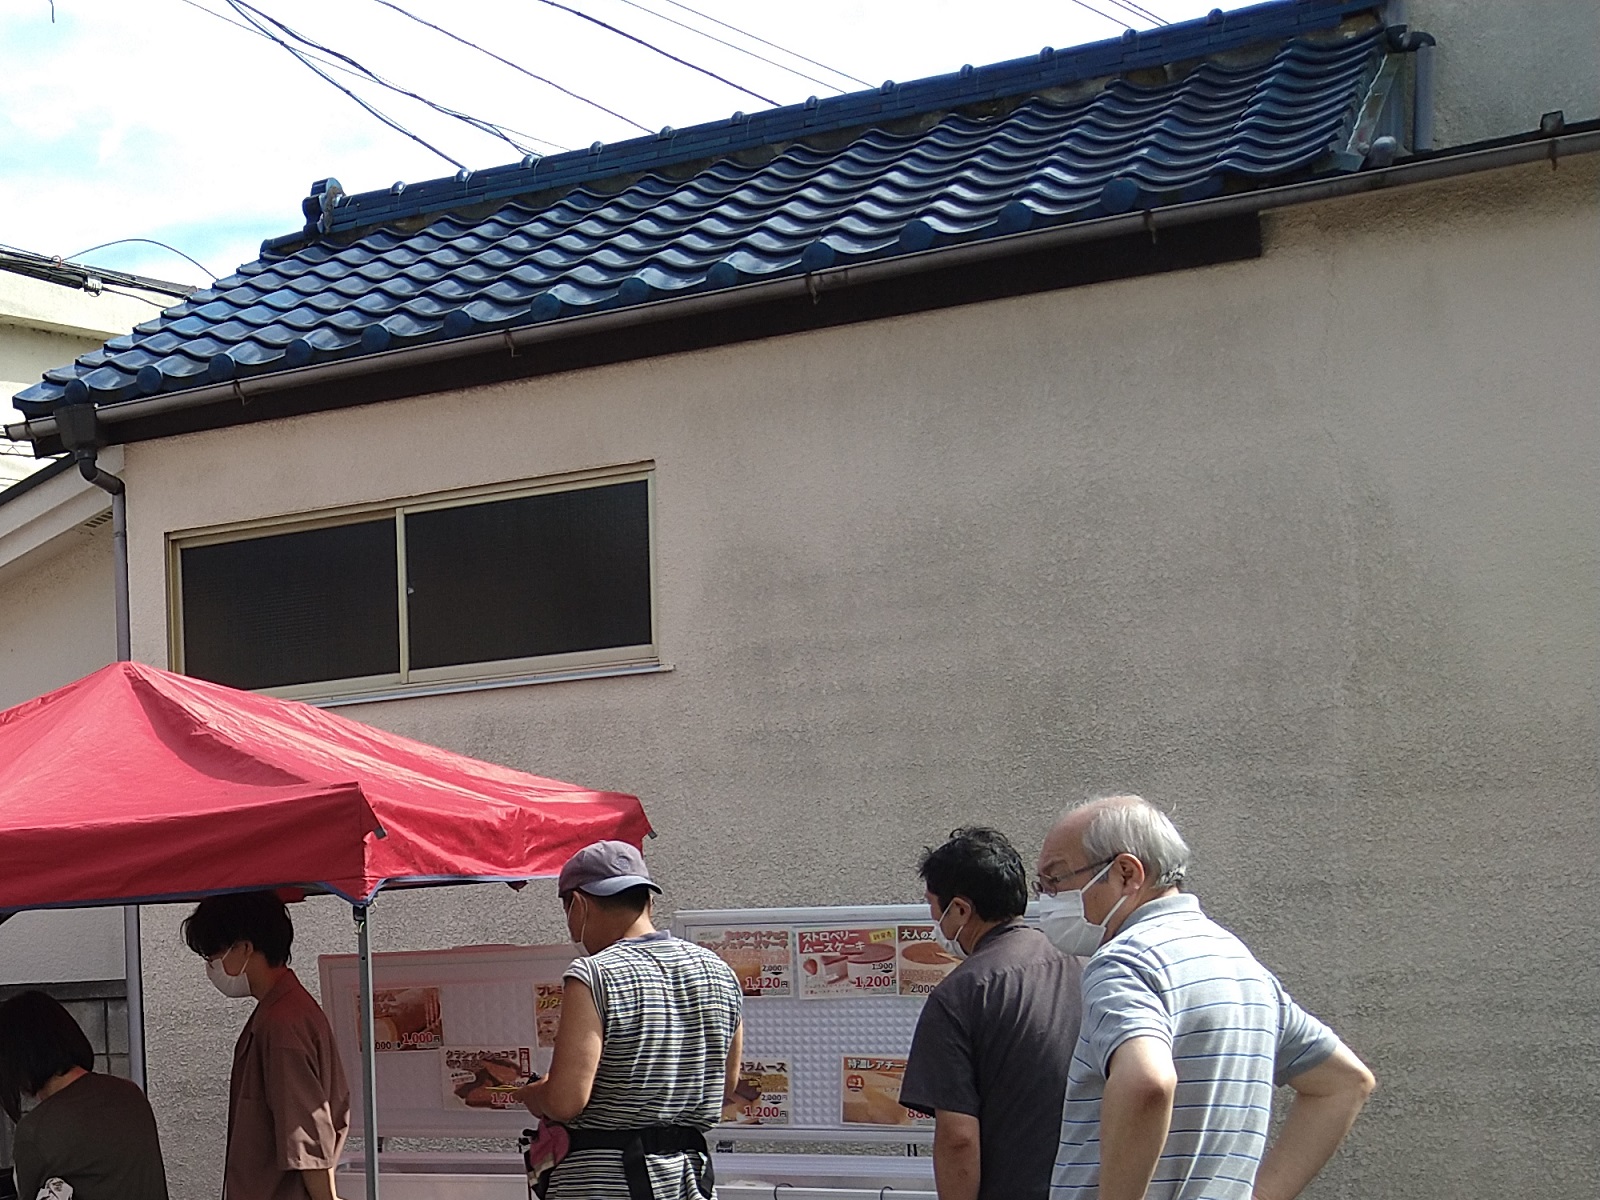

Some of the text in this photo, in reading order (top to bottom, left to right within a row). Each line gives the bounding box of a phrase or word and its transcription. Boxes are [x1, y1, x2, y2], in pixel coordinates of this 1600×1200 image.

[802, 931, 859, 942] ストロベリー
[802, 942, 865, 952] ムースケーキ
[446, 1050, 517, 1060] クラシックショコラ
[847, 1059, 908, 1070] 特濃レアチー
